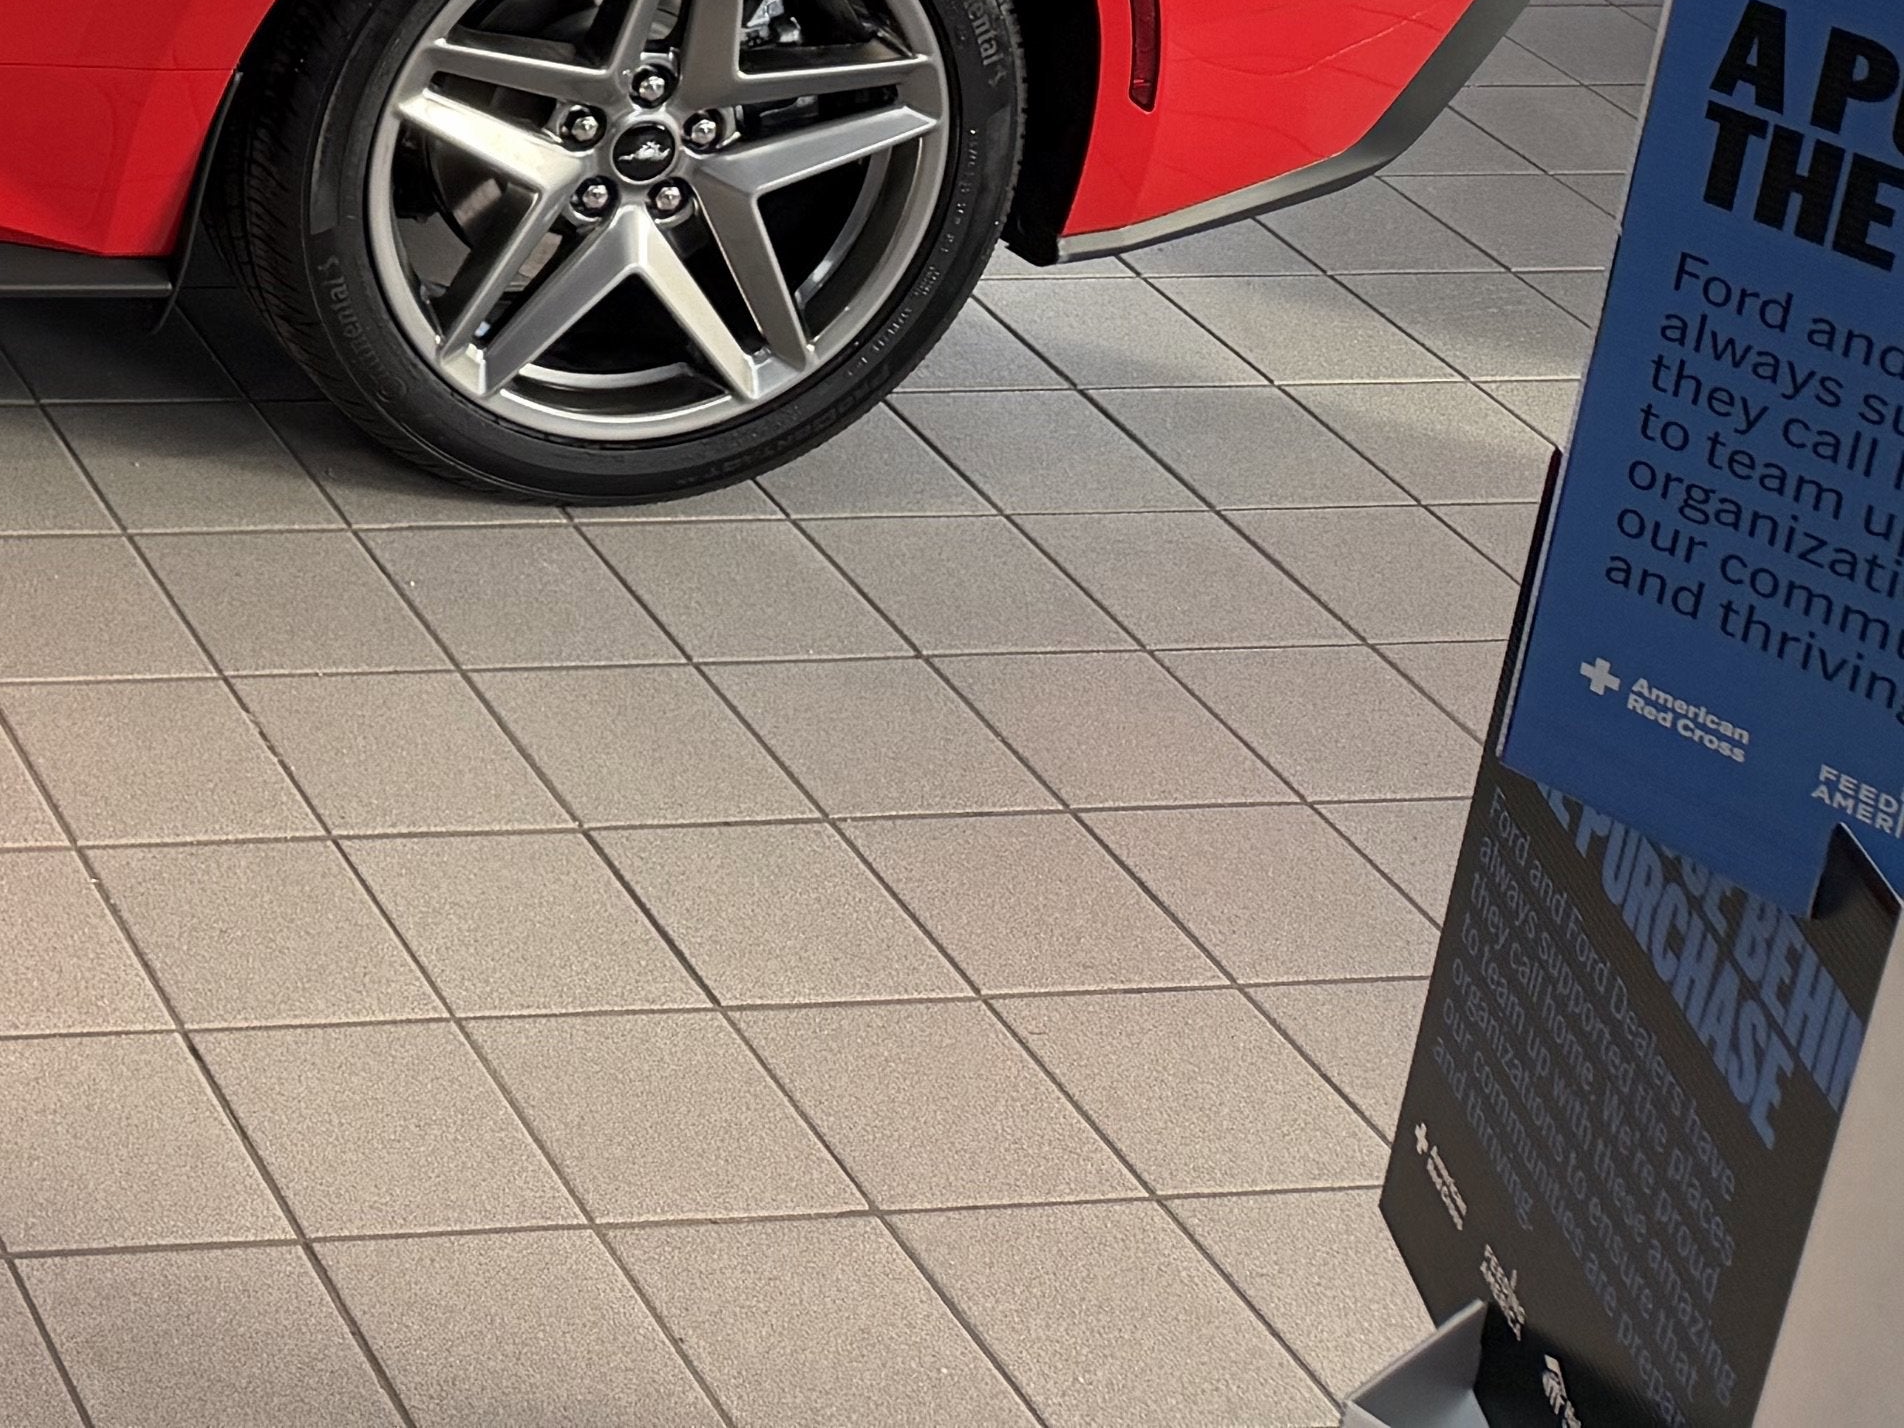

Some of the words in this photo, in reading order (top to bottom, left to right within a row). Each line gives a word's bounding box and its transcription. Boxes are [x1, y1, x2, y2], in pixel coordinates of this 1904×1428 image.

[1810, 25, 1904, 157] P
[1703, 99, 1904, 272] THE
[1660, 313, 1844, 408] always
[1673, 251, 1794, 333] Ford
[1640, 403, 1690, 452] to
[1707, 431, 1843, 520] team
[1863, 504, 1904, 557] u
[1651, 354, 1770, 436] they
[1782, 418, 1879, 478] call
[1605, 555, 1706, 620] and
[1720, 599, 1904, 727] thrivin
[1617, 508, 1708, 564] our
[1720, 554, 1904, 661] comm
[1627, 693, 1673, 728] Red
[1676, 719, 1746, 763] Cross
[1631, 678, 1750, 745] American
[1433, 1038, 1467, 1100] and
[1480, 836, 1537, 939] always
[1538, 931, 1635, 1093] supported
[1668, 1147, 1735, 1266] places
[1490, 785, 1530, 866] Ford
[1529, 860, 1568, 924] and
[1567, 906, 1610, 993] Ford
[1611, 976, 1683, 1118] Dealers
[1685, 1096, 1735, 1202] have
[1443, 998, 1473, 1052] our
[1473, 1051, 1585, 1257] communities
[1461, 912, 1479, 955] to
[1481, 945, 1525, 1033] team
[1527, 1028, 1551, 1081] up
[1594, 1140, 1648, 1243] these
[1648, 1238, 1737, 1407] amazing
[1472, 872, 1509, 950] they
[1510, 944, 1542, 1004] call
[1655, 1188, 1721, 1304] proud
[1452, 957, 1564, 1162] organizations
[1568, 1150, 1588, 1200] to
[1589, 1196, 1653, 1320] ensure
[1656, 1307, 1697, 1402] that
